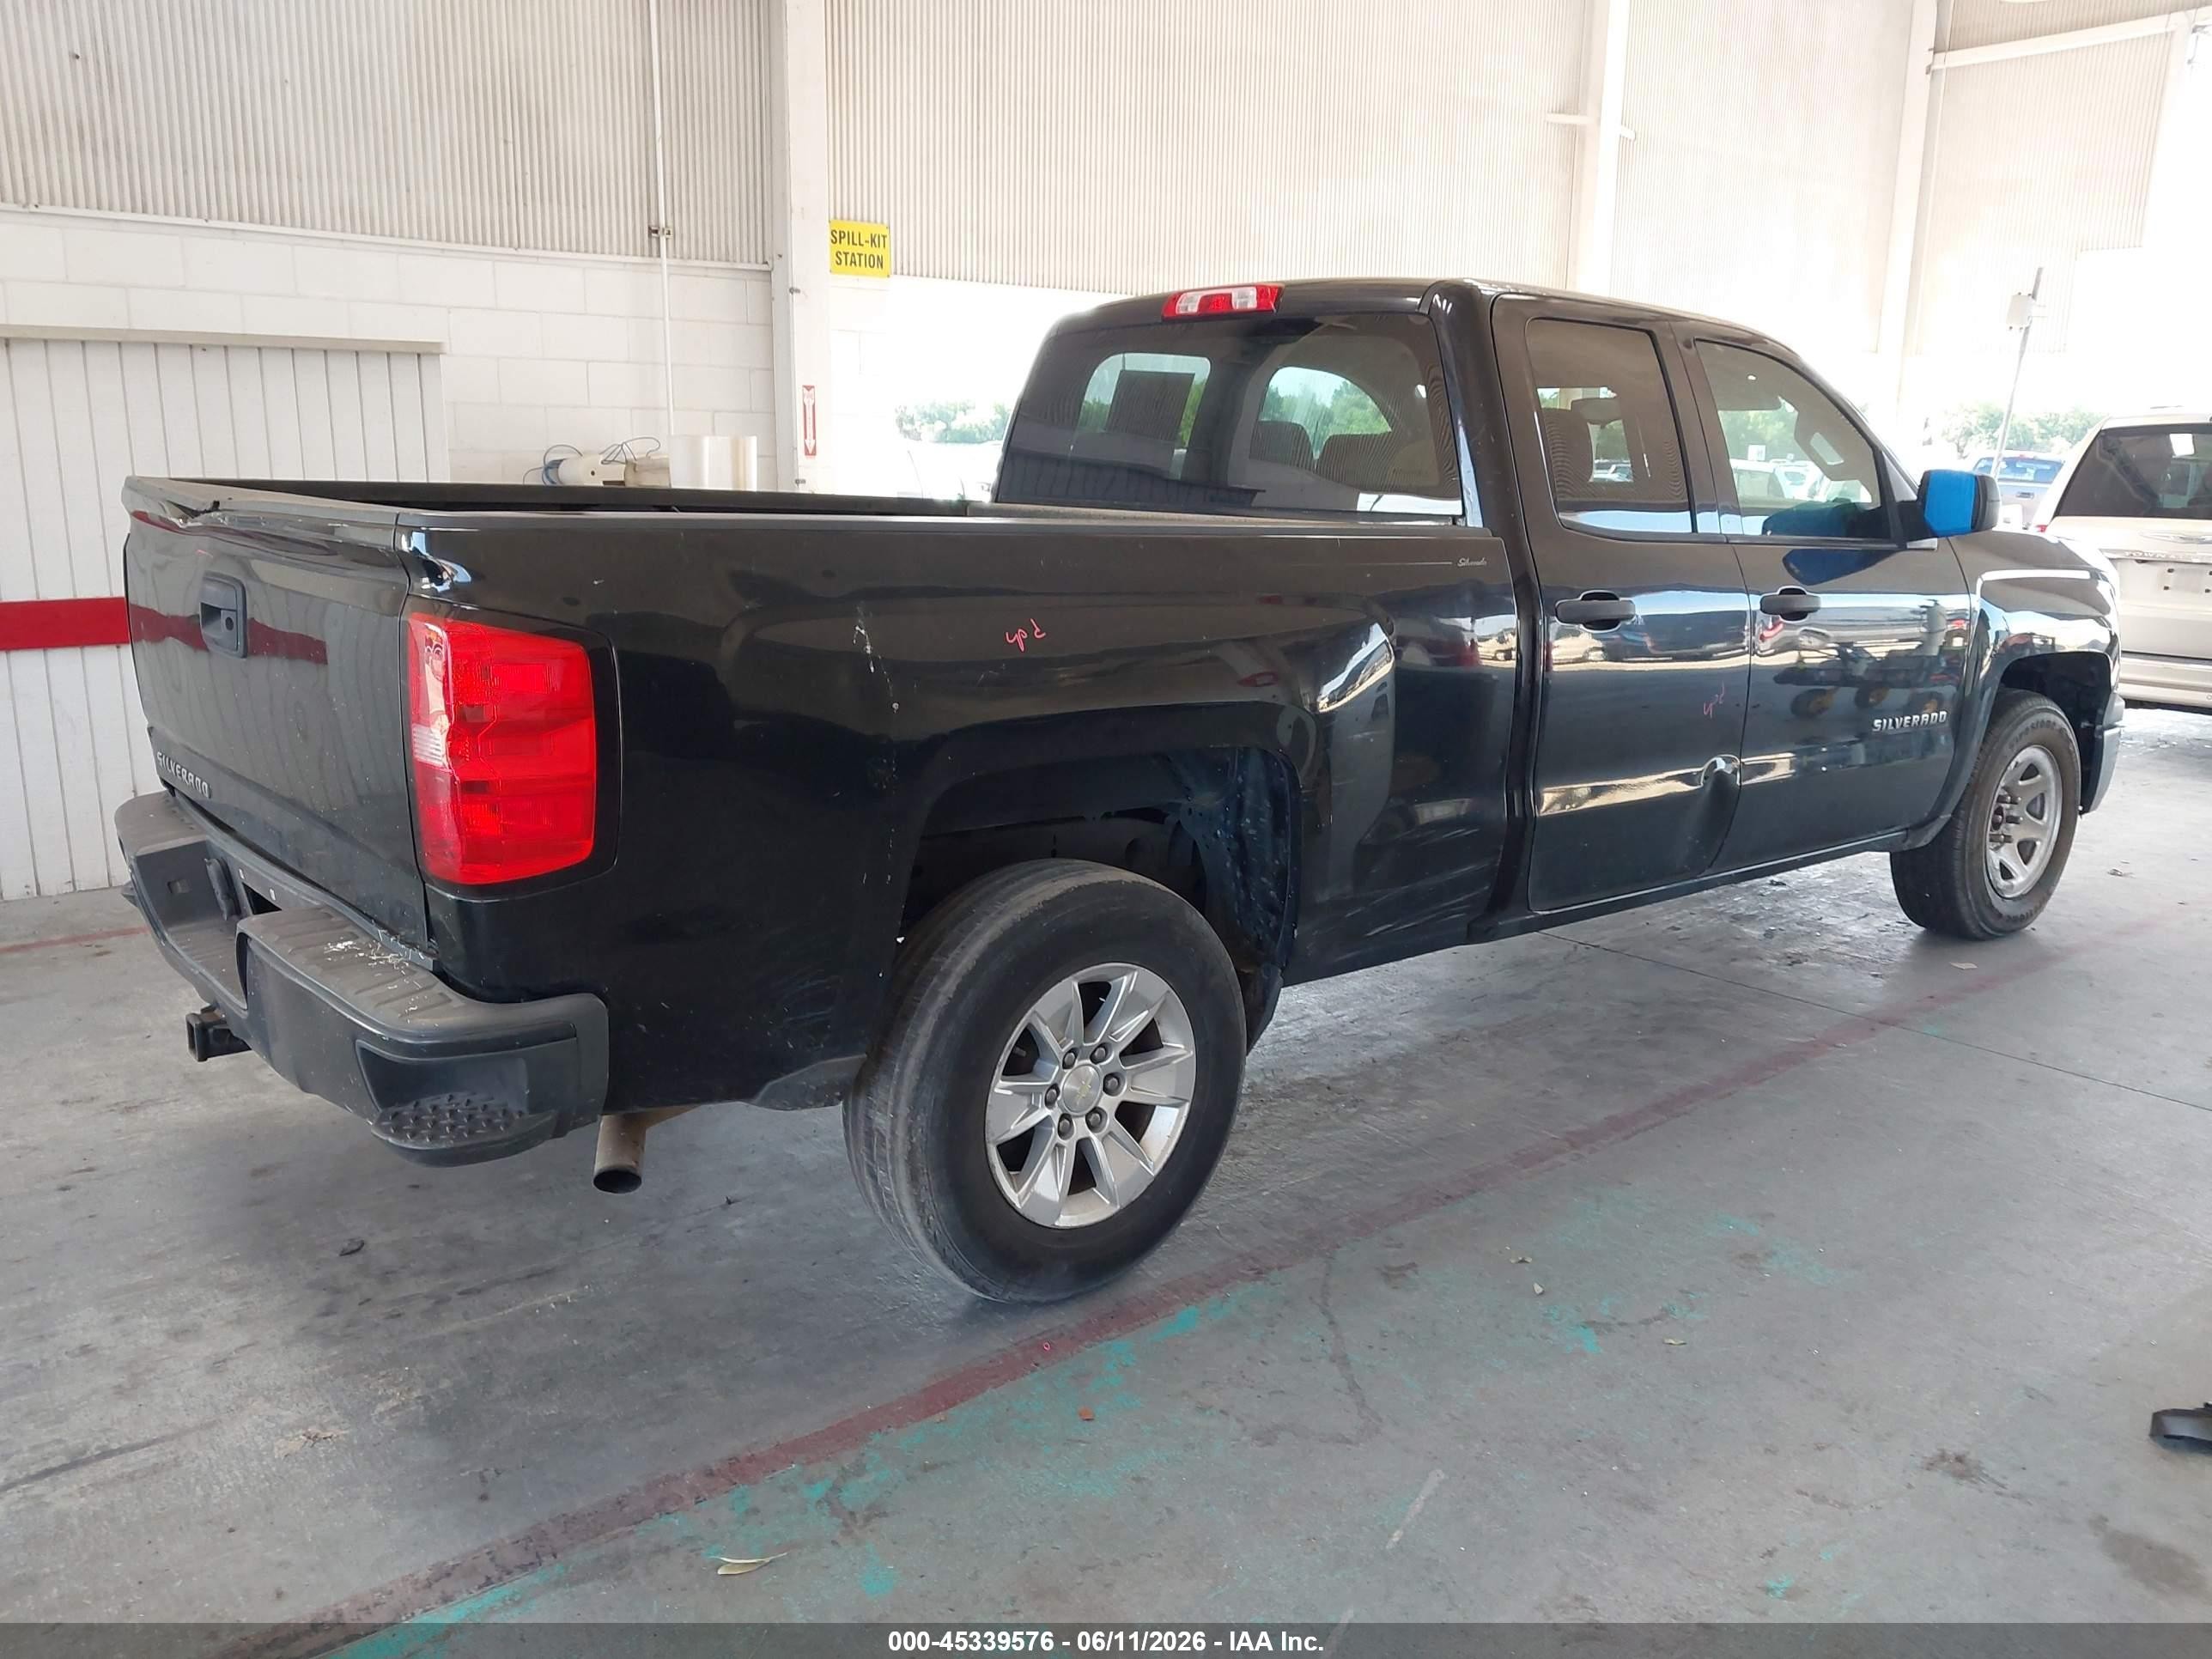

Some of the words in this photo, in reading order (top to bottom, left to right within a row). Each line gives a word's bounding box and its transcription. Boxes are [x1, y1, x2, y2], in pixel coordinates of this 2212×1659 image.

[830, 229, 888, 249] SPILL-KIT
[835, 250, 884, 270] STATION
[1872, 710, 1948, 732] SILVERADO
[156, 750, 210, 799] SILVERADO
